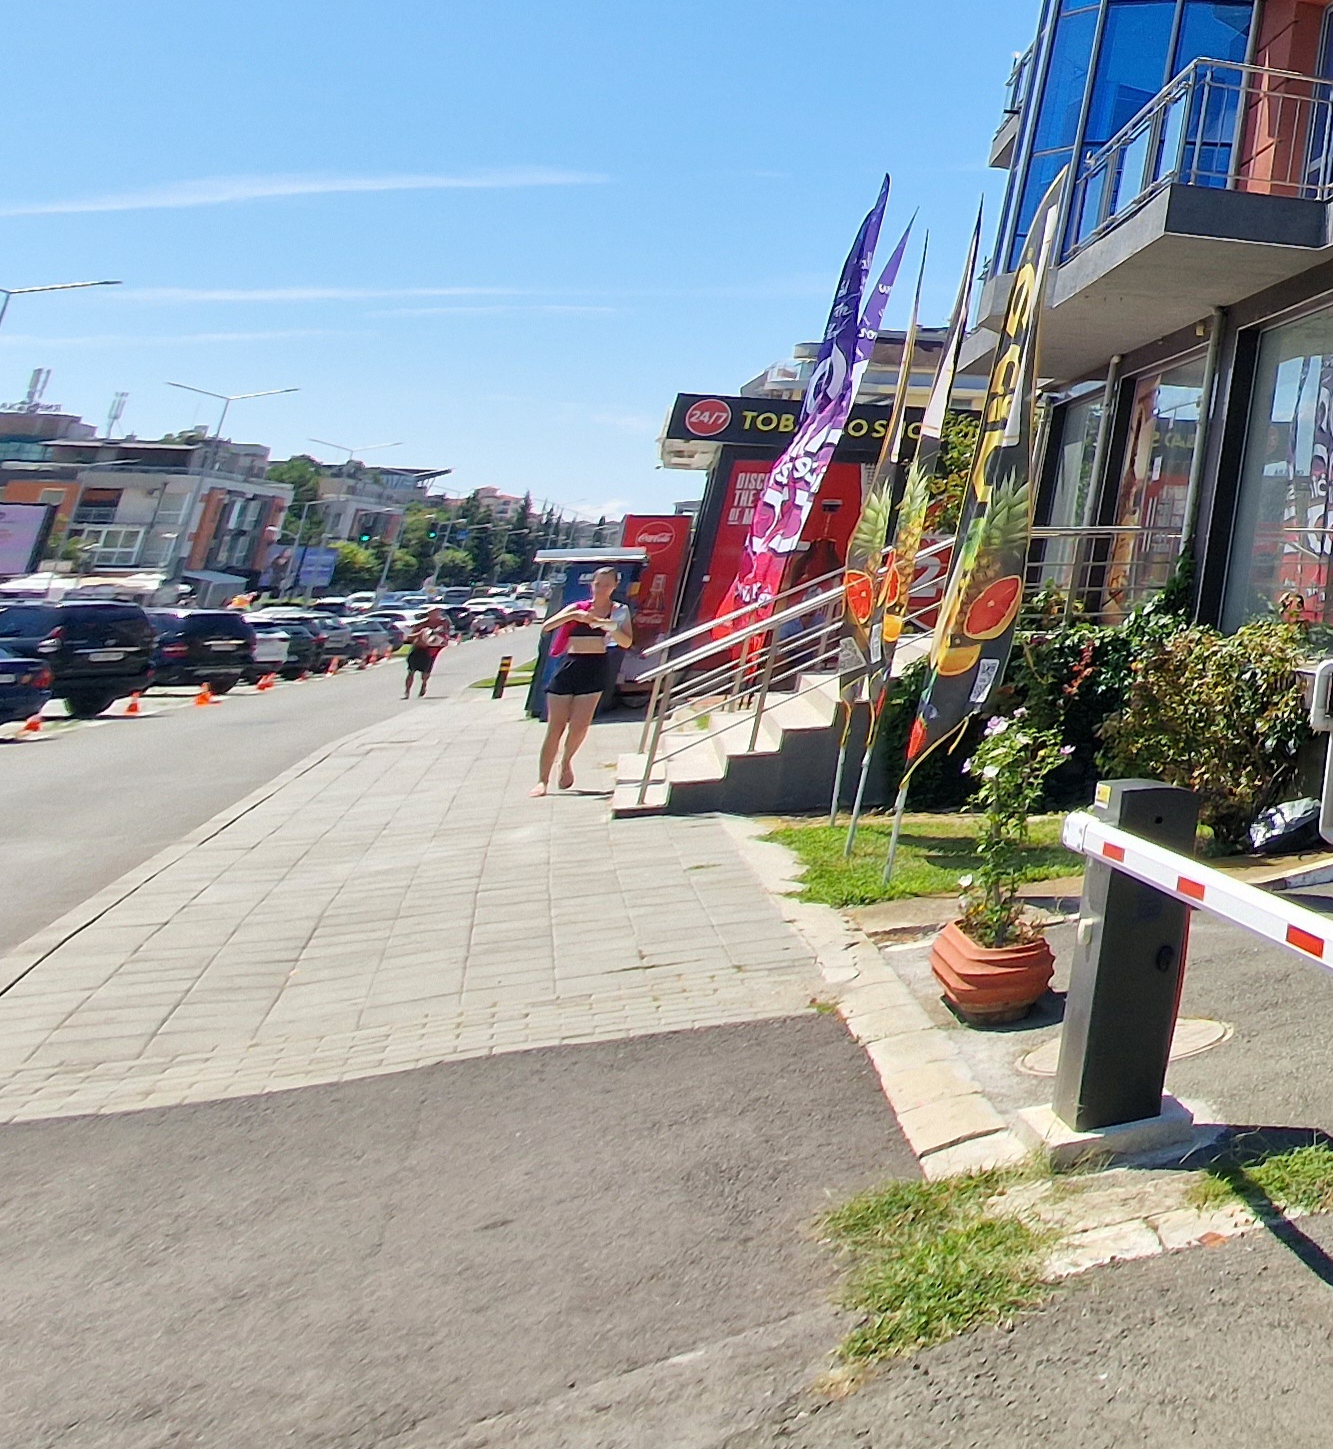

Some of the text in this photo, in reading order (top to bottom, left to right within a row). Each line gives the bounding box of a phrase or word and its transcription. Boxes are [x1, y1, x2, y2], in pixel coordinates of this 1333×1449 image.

[689, 410, 728, 425] 24/7
[742, 411, 868, 437] TOBO
[733, 490, 757, 507] THE
[727, 508, 742, 524] OF
